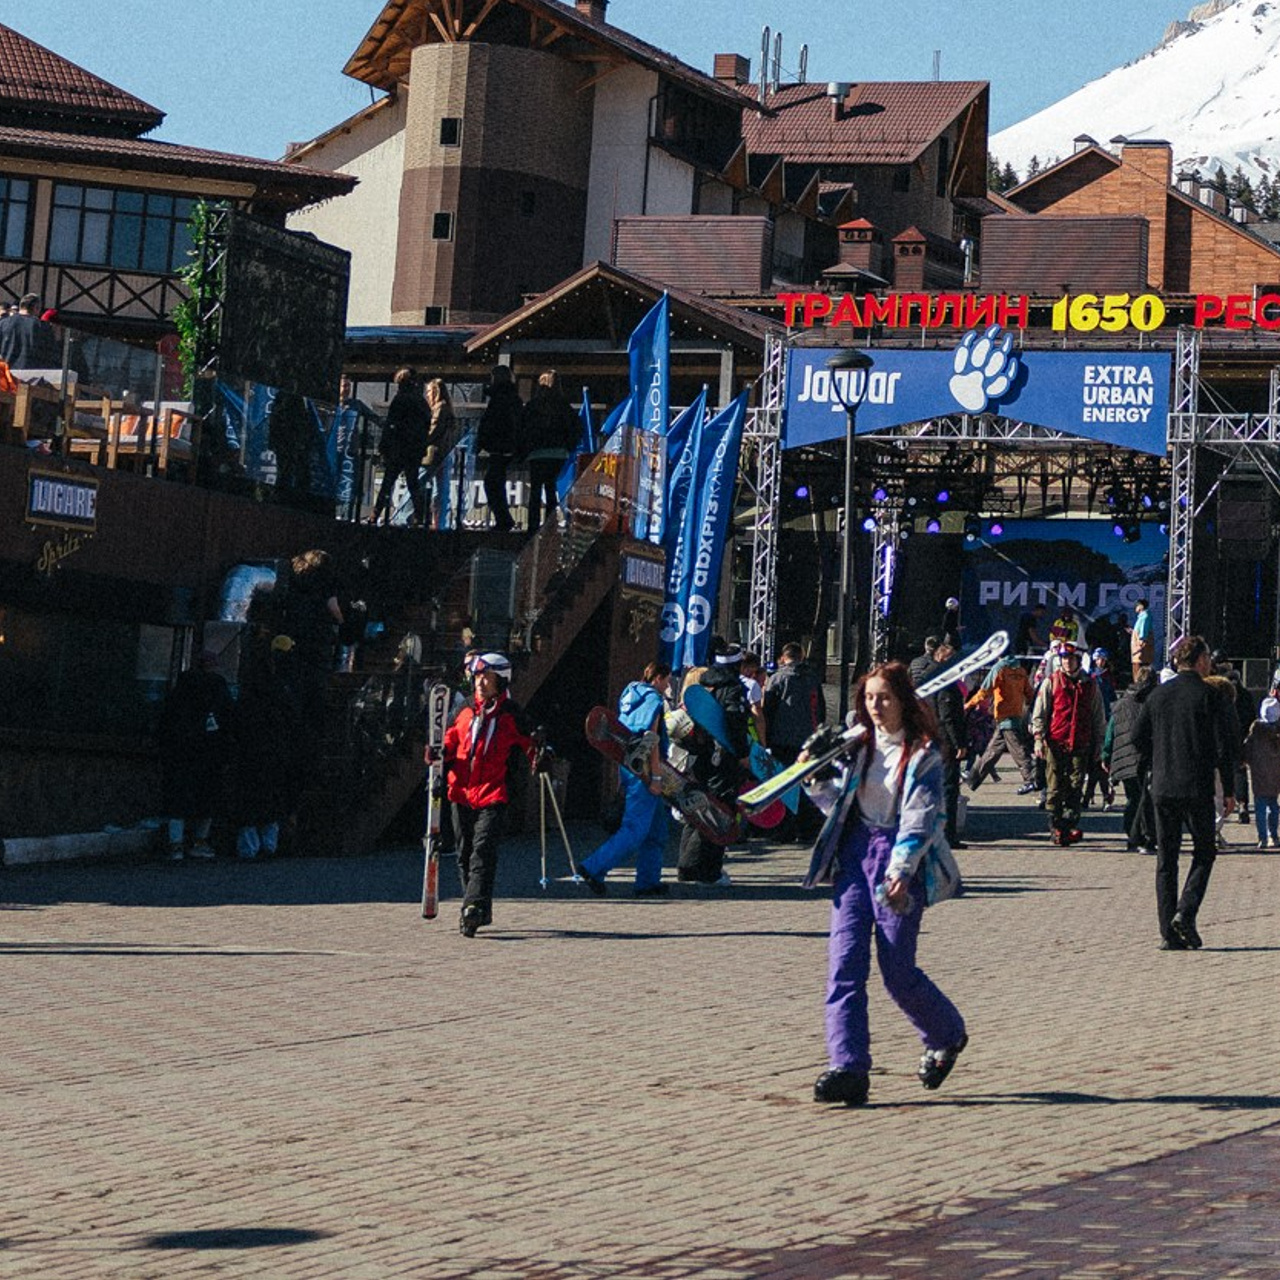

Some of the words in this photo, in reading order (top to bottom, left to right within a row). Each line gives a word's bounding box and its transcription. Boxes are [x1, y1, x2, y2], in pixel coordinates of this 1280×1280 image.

[776, 293, 1029, 328] ТРАМПЛИН
[1051, 293, 1166, 331] 1650
[1084, 366, 1153, 384] EXTRA
[797, 365, 901, 412] Jaguar
[1083, 386, 1153, 405] URBAN
[1083, 407, 1151, 423] ENERGY
[979, 581, 1086, 607] РИТМ
